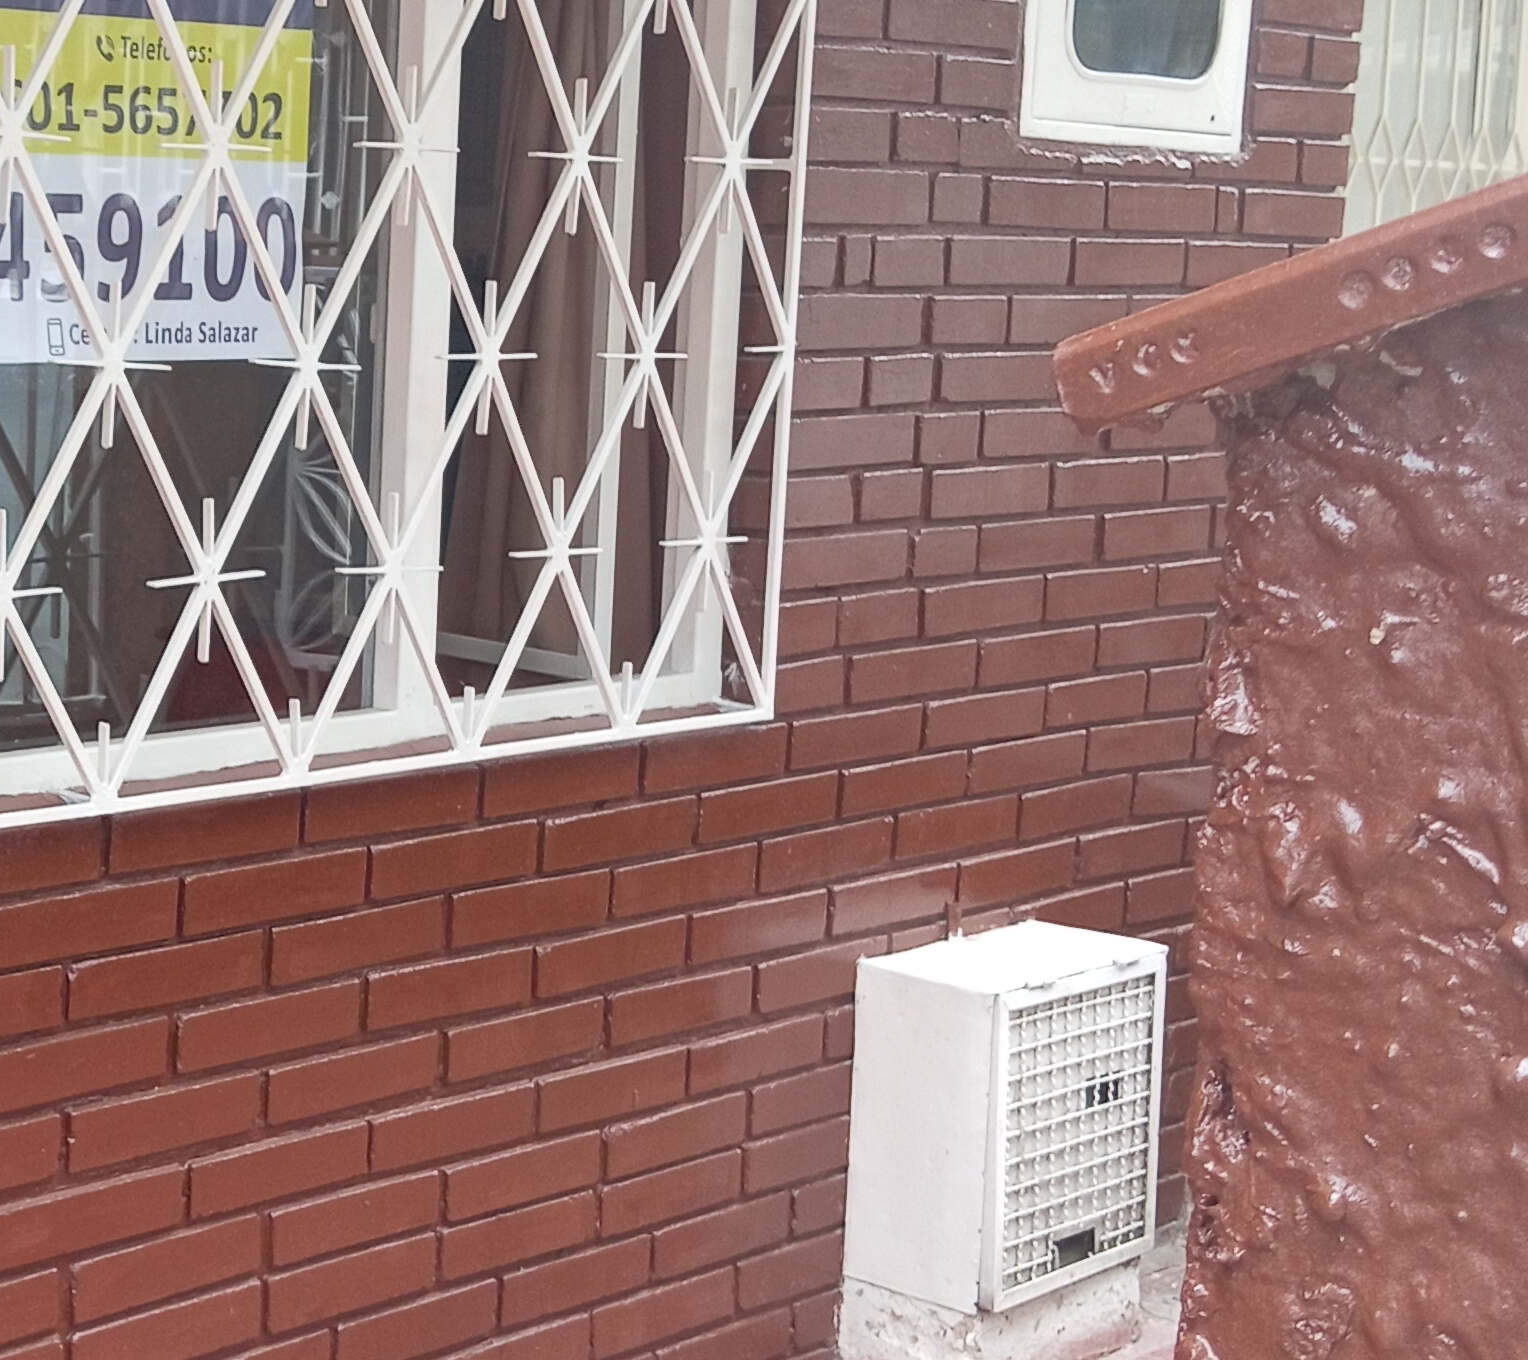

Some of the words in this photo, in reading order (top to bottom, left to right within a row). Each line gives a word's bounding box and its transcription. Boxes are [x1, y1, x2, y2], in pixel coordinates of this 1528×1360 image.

[8, 77, 284, 141] 01-56502
[145, 321, 192, 344] Linda
[198, 320, 259, 344] Salazar
